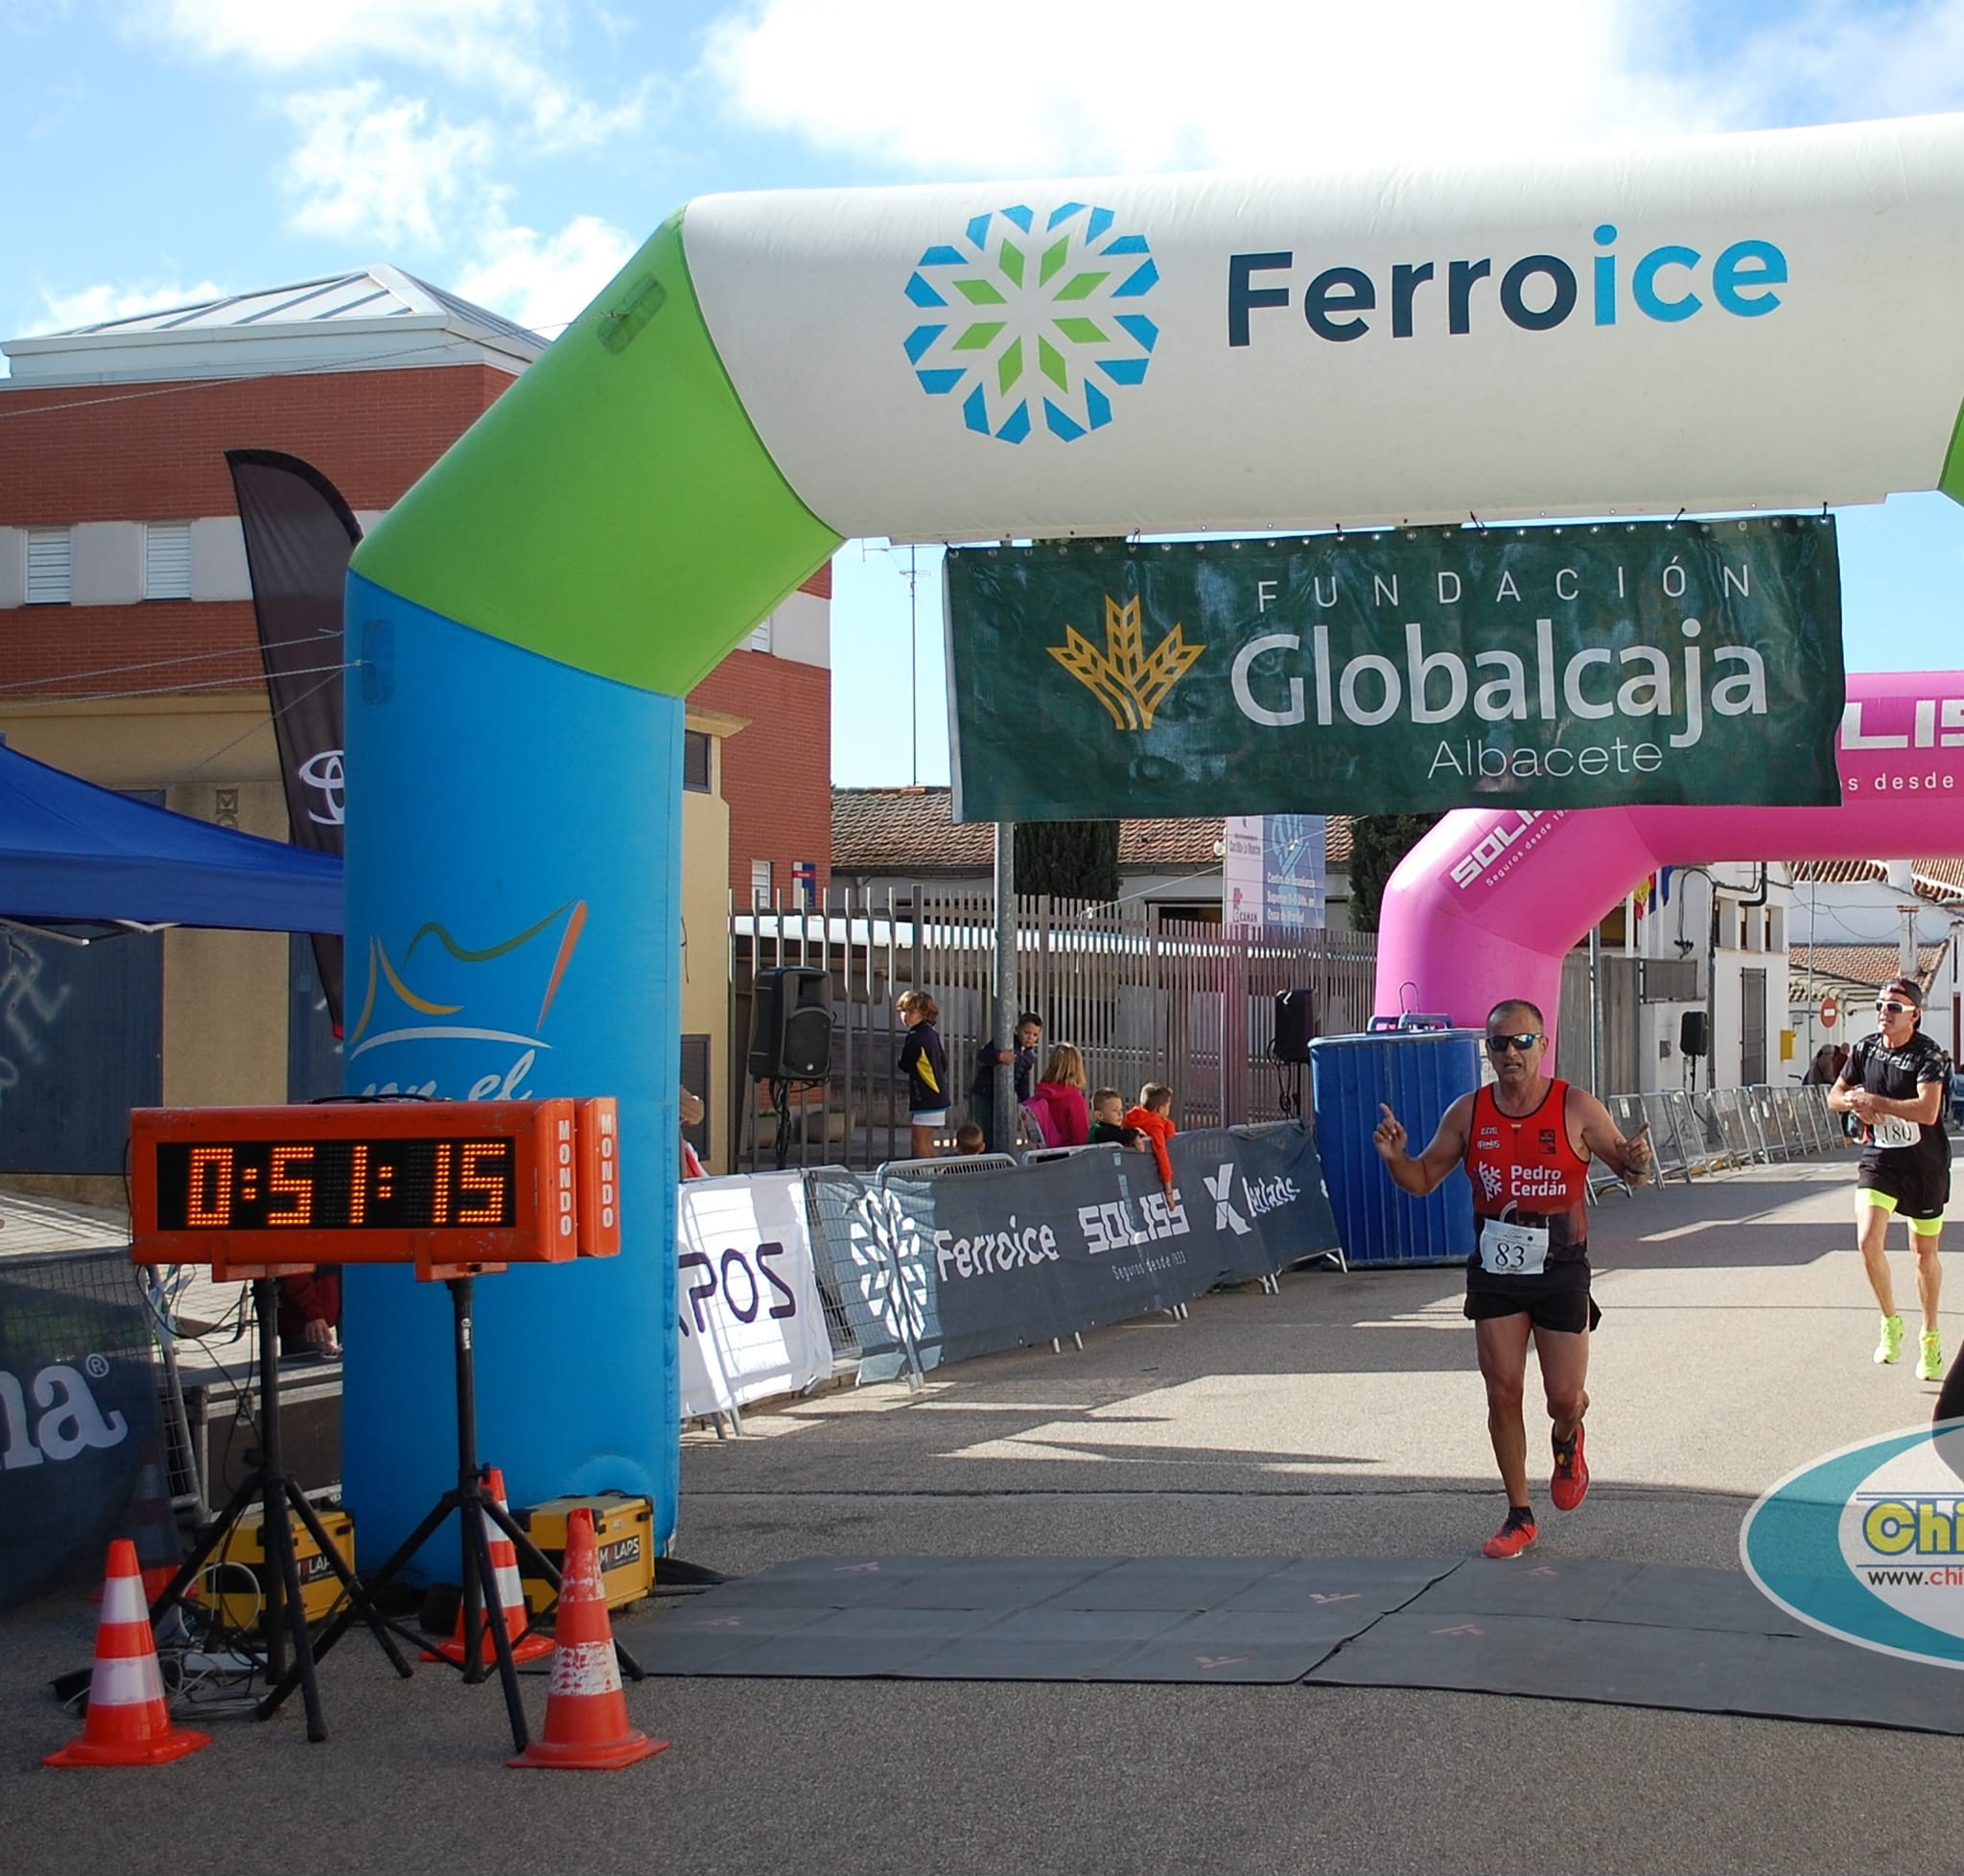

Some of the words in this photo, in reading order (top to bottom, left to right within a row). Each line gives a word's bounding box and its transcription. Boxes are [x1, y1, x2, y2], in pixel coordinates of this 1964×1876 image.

[1228, 223, 1789, 348] Ferroice
[1257, 554, 1750, 613] FUNDACIÓN
[1230, 618, 1768, 749] Globalcaja
[1427, 735, 1664, 779] Albacete
[1874, 771, 1954, 790] desde
[1450, 809, 1543, 889] SOLI
[1486, 850, 1524, 886] Seguros
[1525, 823, 1552, 850] desde
[1881, 1123, 1912, 1143] 180
[558, 1119, 573, 1236] MONDO
[600, 1114, 614, 1228] MONDO
[1510, 1164, 1562, 1181] Pedro
[1510, 1181, 1567, 1196] Cerdán
[933, 1214, 1061, 1282] Ferroice
[1077, 1188, 1191, 1255] SOLISS
[1495, 1242, 1526, 1268] 83
